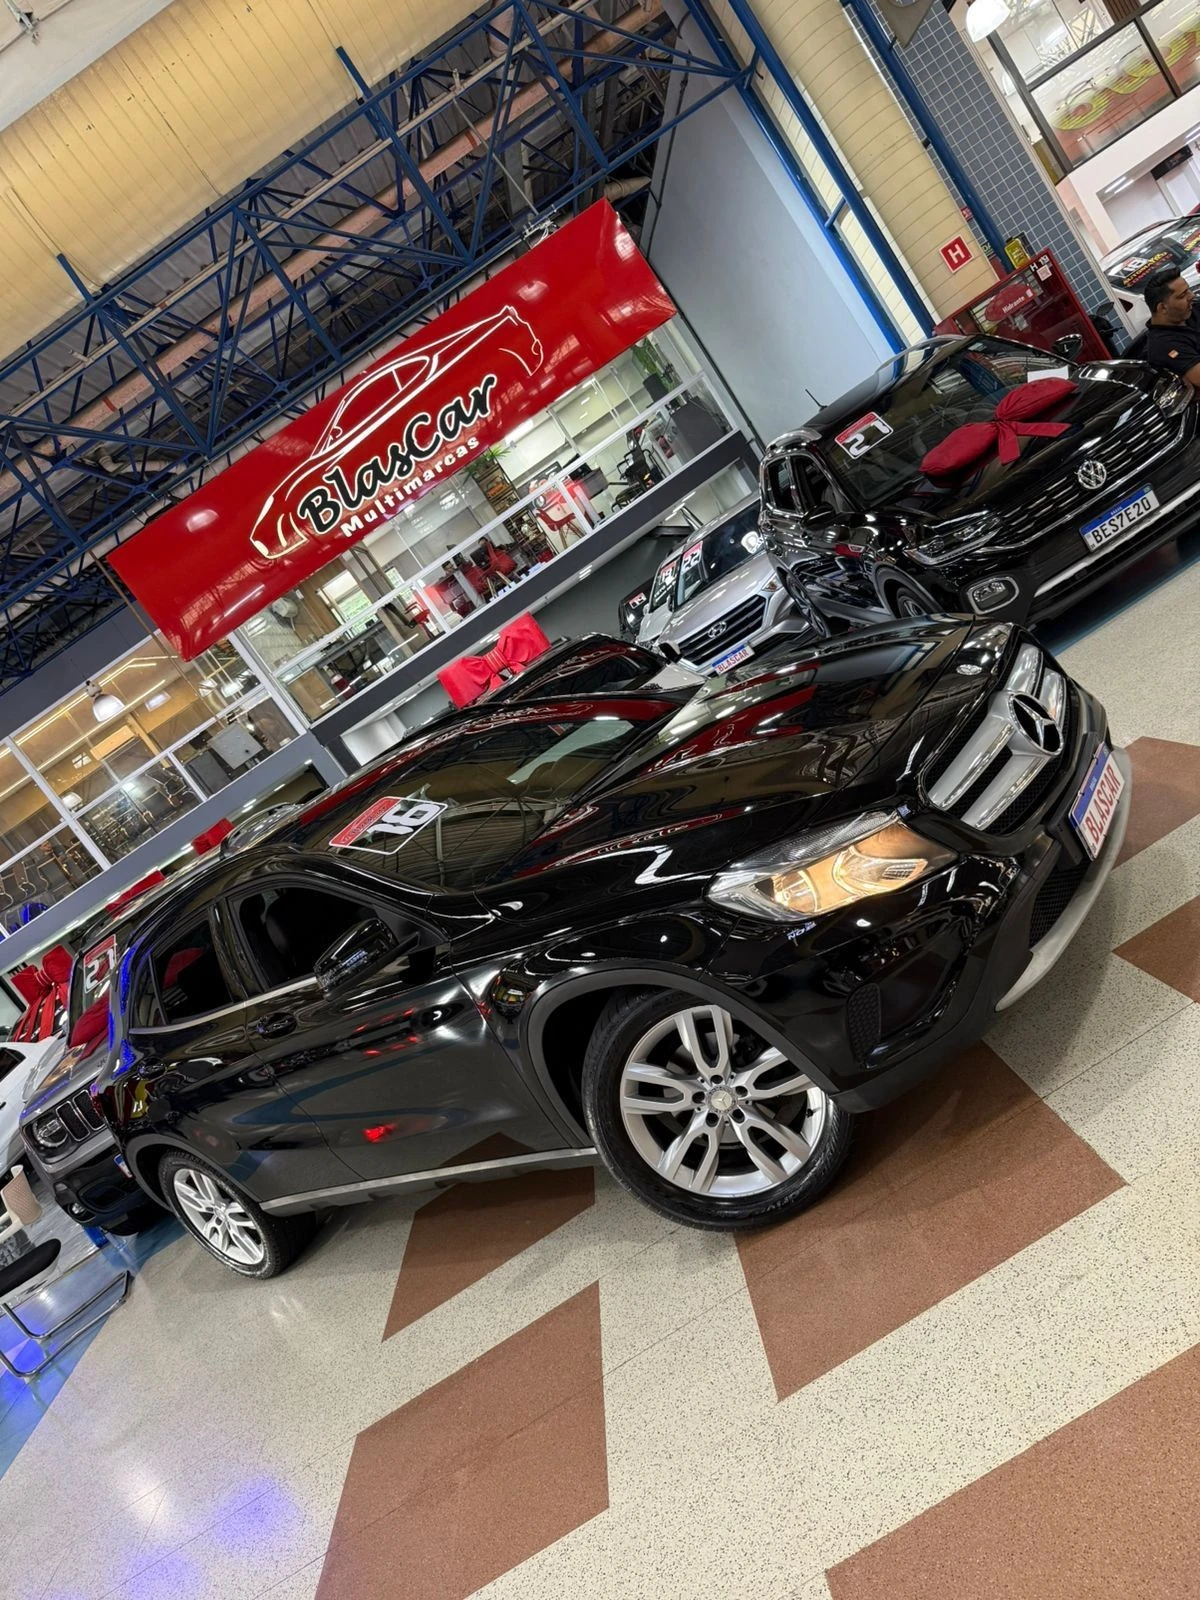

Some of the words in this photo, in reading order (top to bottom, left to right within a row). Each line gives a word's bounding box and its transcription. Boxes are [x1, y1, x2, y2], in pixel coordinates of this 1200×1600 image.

[947, 243, 966, 264] H
[1029, 262, 1039, 272] H
[1002, 296, 1025, 314] Hidrante
[298, 373, 497, 535] BlasCar
[340, 435, 479, 537] Multimarcas
[1091, 496, 1152, 544] BES7E20
[717, 648, 750, 671] BLASCAR
[366, 803, 441, 835] 16
[1085, 763, 1121, 845] BLASCAR
[86, 948, 115, 989] 21
